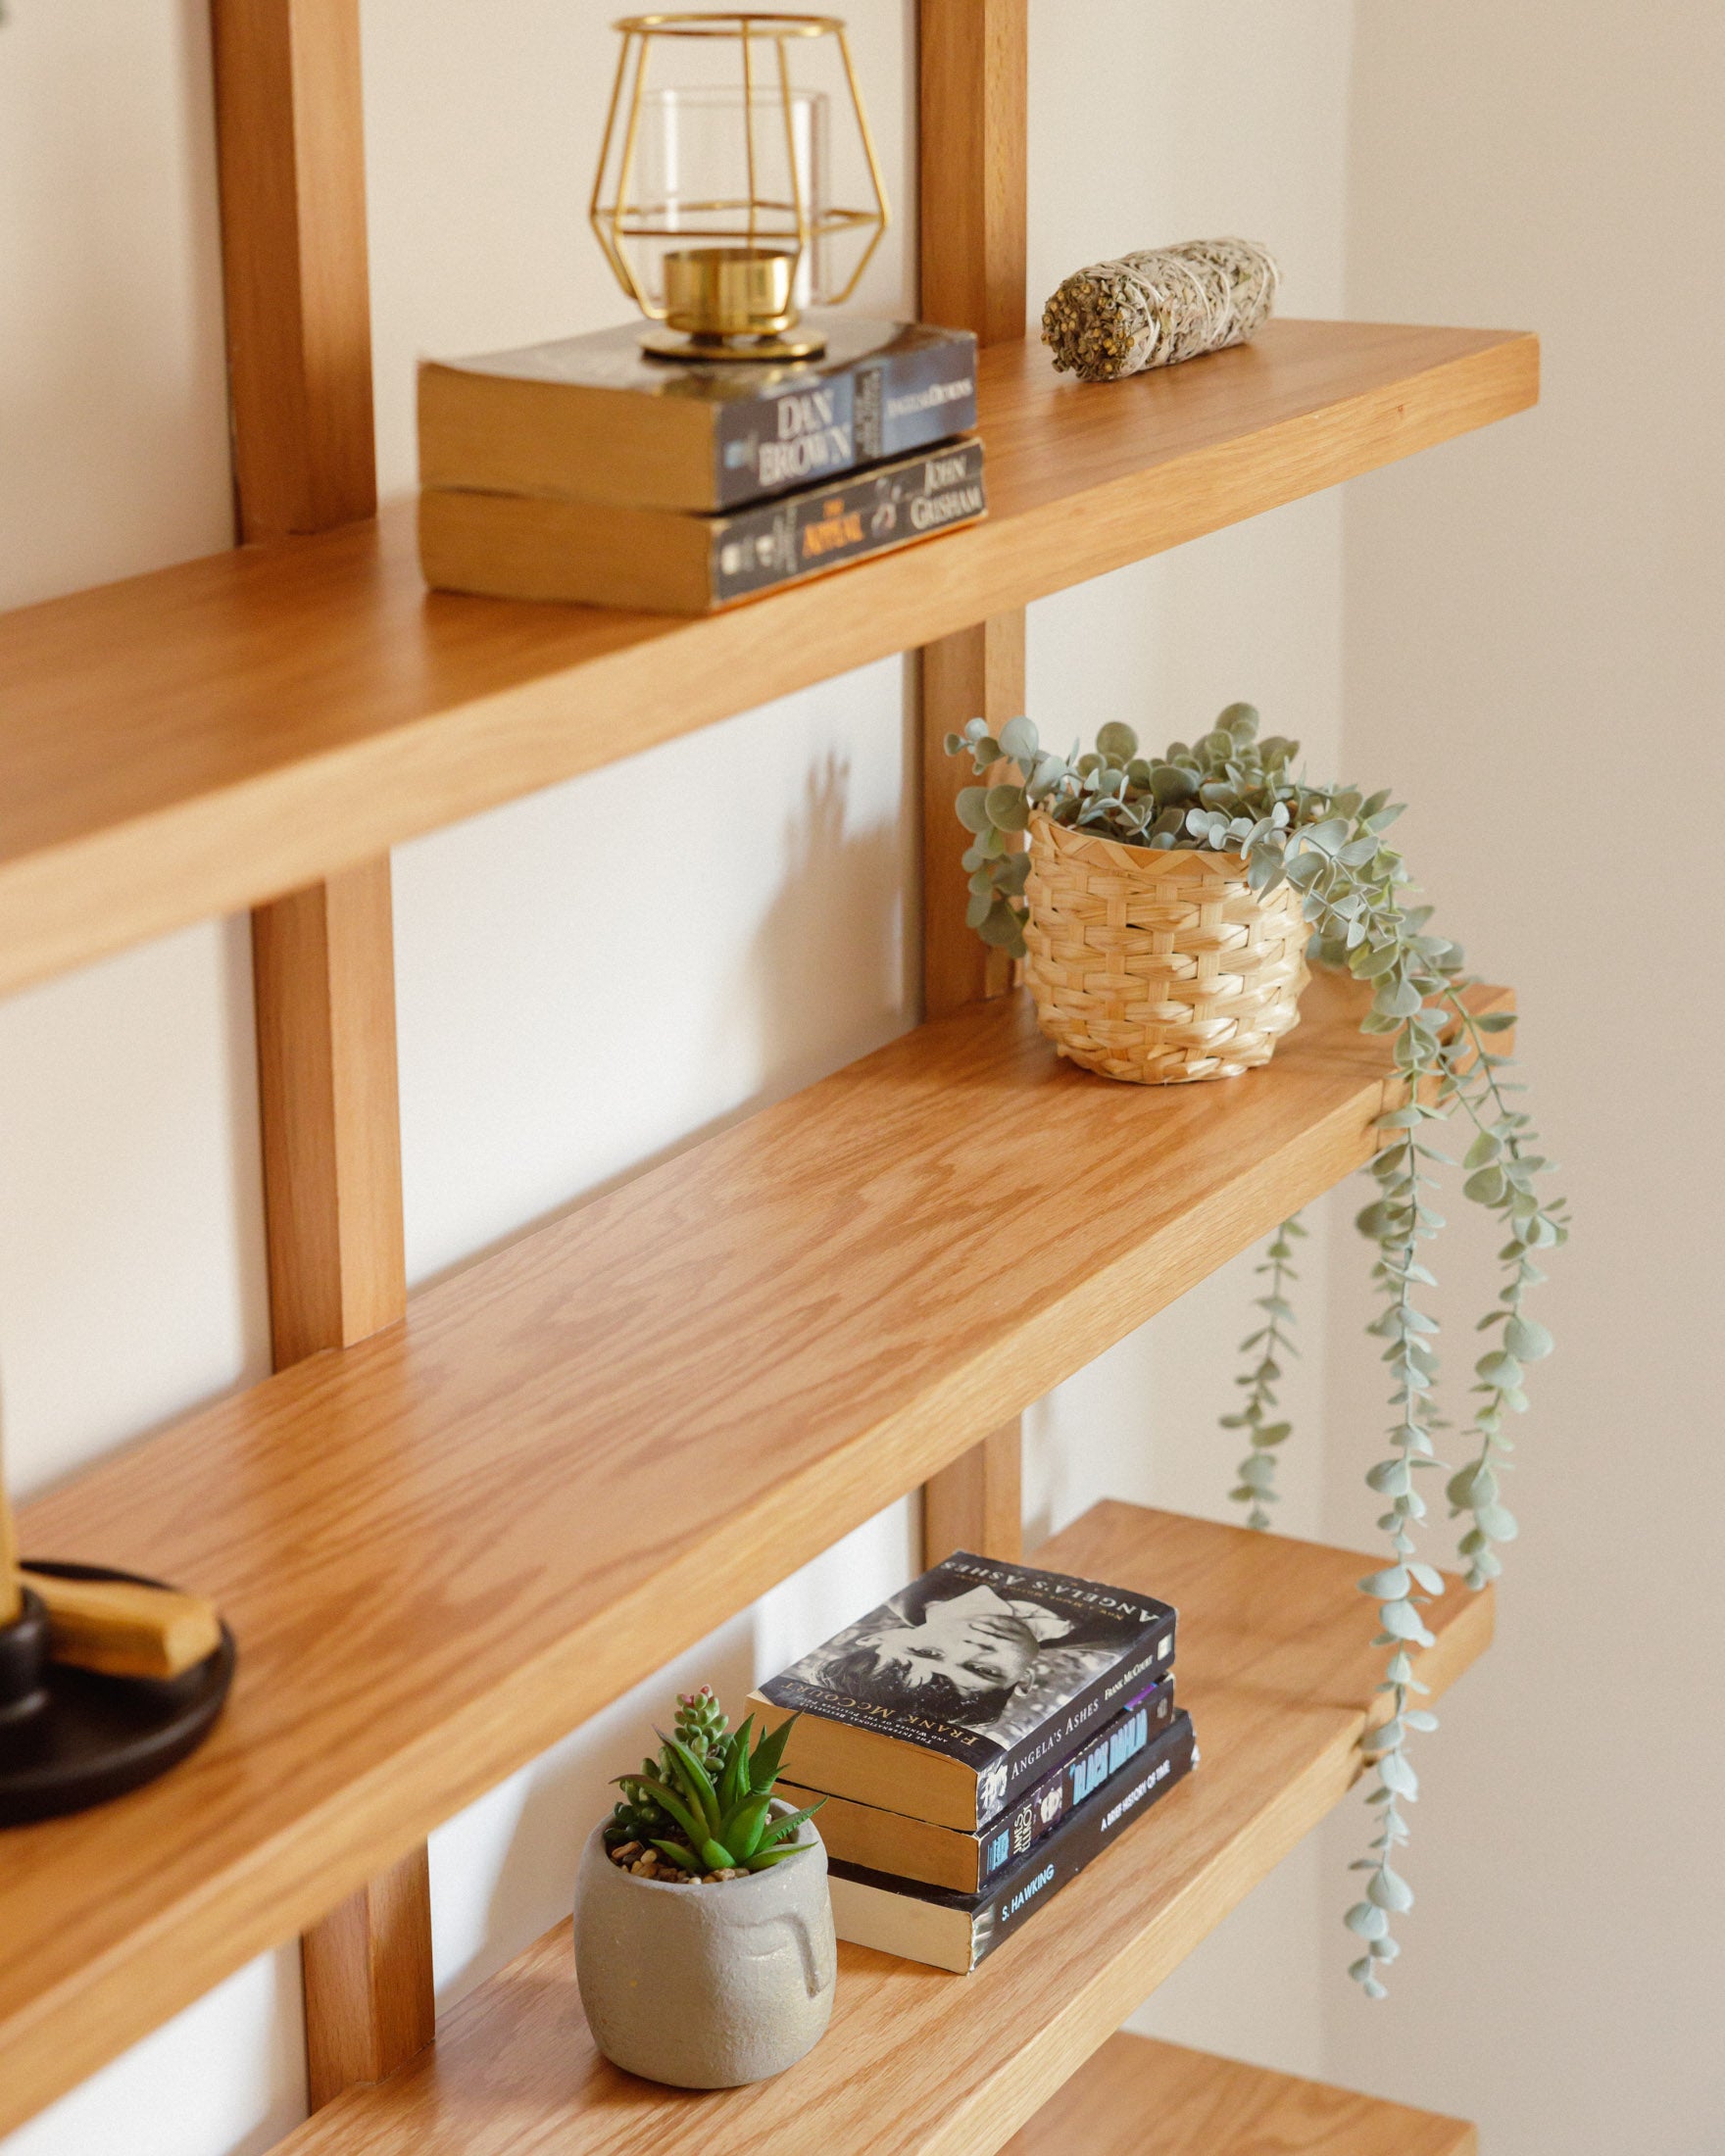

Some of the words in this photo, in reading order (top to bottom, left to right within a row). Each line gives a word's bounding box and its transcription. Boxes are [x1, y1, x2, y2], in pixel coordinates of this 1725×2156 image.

[778, 389, 835, 441] DAN
[760, 424, 852, 487] BROWN
[941, 1561, 1026, 1586] ASHES
[1033, 1580, 1160, 1624] ANGELA'S
[908, 1714, 979, 1746] FRANK
[1011, 1730, 1062, 1781] ANGELA'S
[1065, 1698, 1101, 1736] ASHES
[1013, 1813, 1023, 1854] JAMES
[1002, 1905, 1010, 1922] S.
[1011, 1863, 1055, 1913] HAWKING
